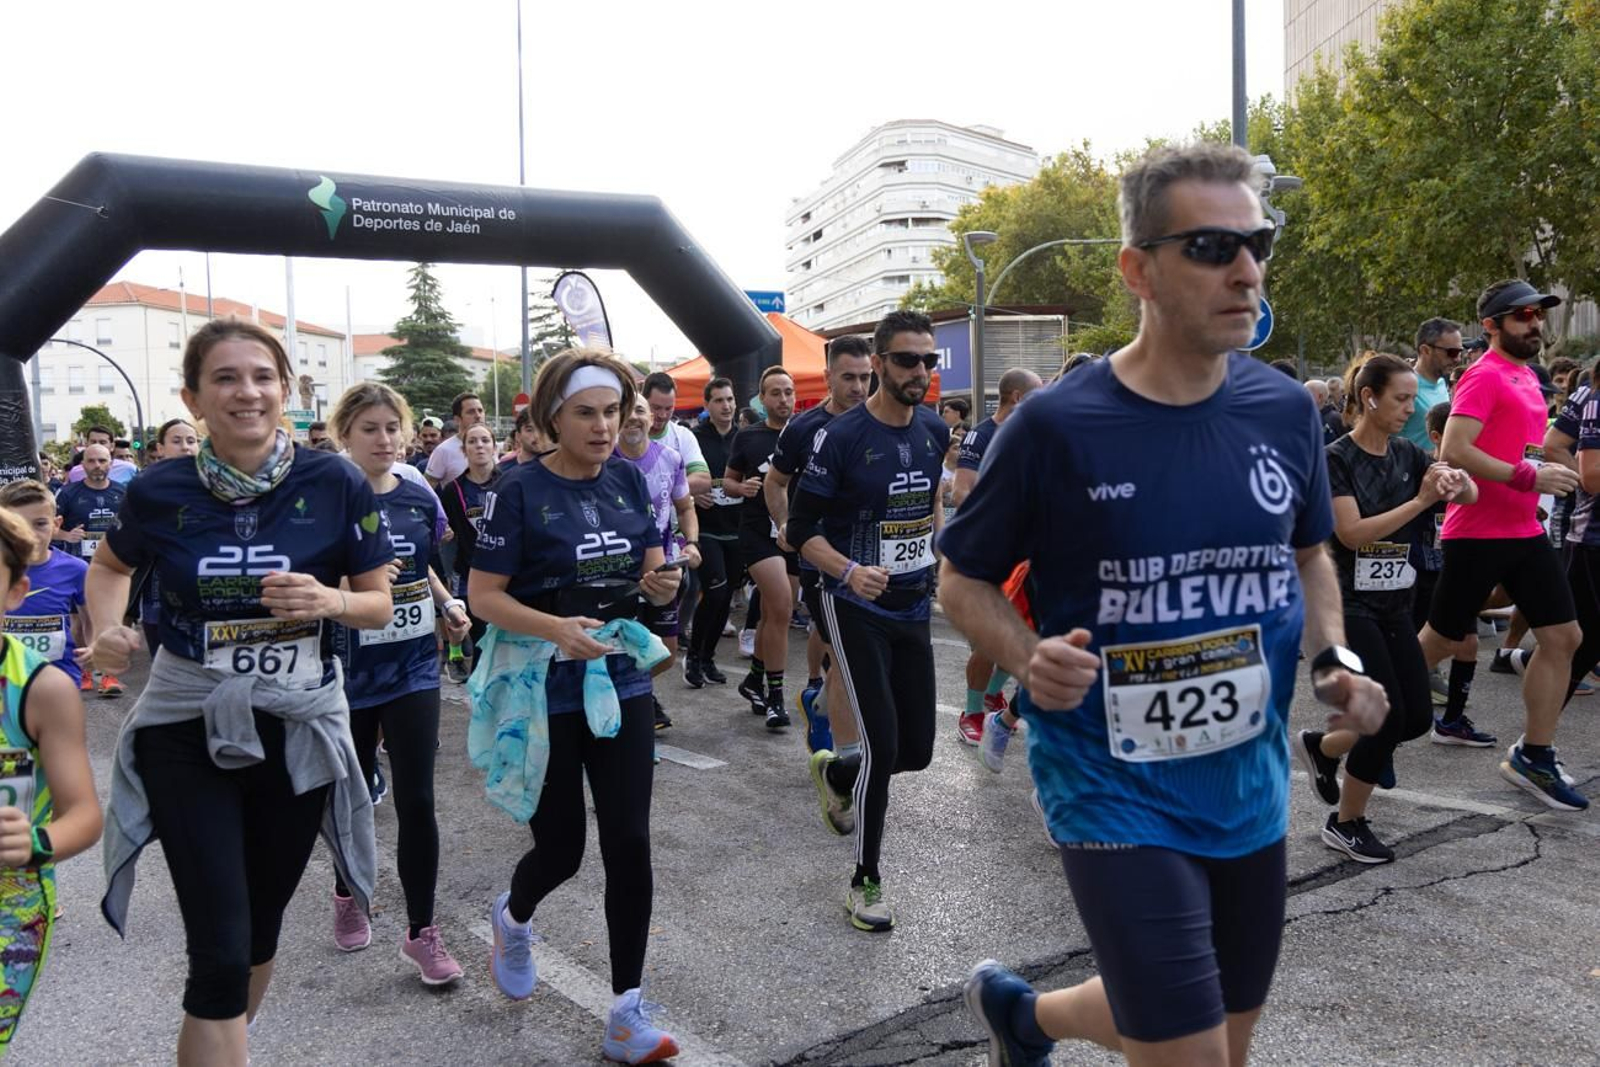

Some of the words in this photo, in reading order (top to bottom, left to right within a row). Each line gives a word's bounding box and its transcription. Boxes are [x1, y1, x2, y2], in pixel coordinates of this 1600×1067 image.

[352, 197, 424, 215] Patronato
[427, 202, 495, 219] Municipal
[499, 207, 516, 220] de
[353, 214, 421, 231] Deportes
[424, 221, 443, 232] de
[446, 220, 481, 234] Jaén
[888, 470, 931, 495] 25
[1088, 482, 1136, 501] vive
[89, 508, 114, 519] 25
[576, 531, 632, 560] 25
[894, 539, 926, 562] 298
[197, 545, 291, 576] 25
[1098, 555, 1165, 582] CLUB
[1370, 561, 1407, 579] 237
[197, 576, 263, 587] CARRE
[199, 587, 265, 598] POPUL
[1097, 569, 1291, 625] BULEVAR
[393, 604, 422, 629] 39
[211, 625, 240, 640] XXV
[20, 635, 51, 653] 98
[1147, 641, 1201, 660] CARRERA
[232, 644, 299, 674] 667
[1163, 654, 1196, 671] gran
[1144, 680, 1240, 732] 423
